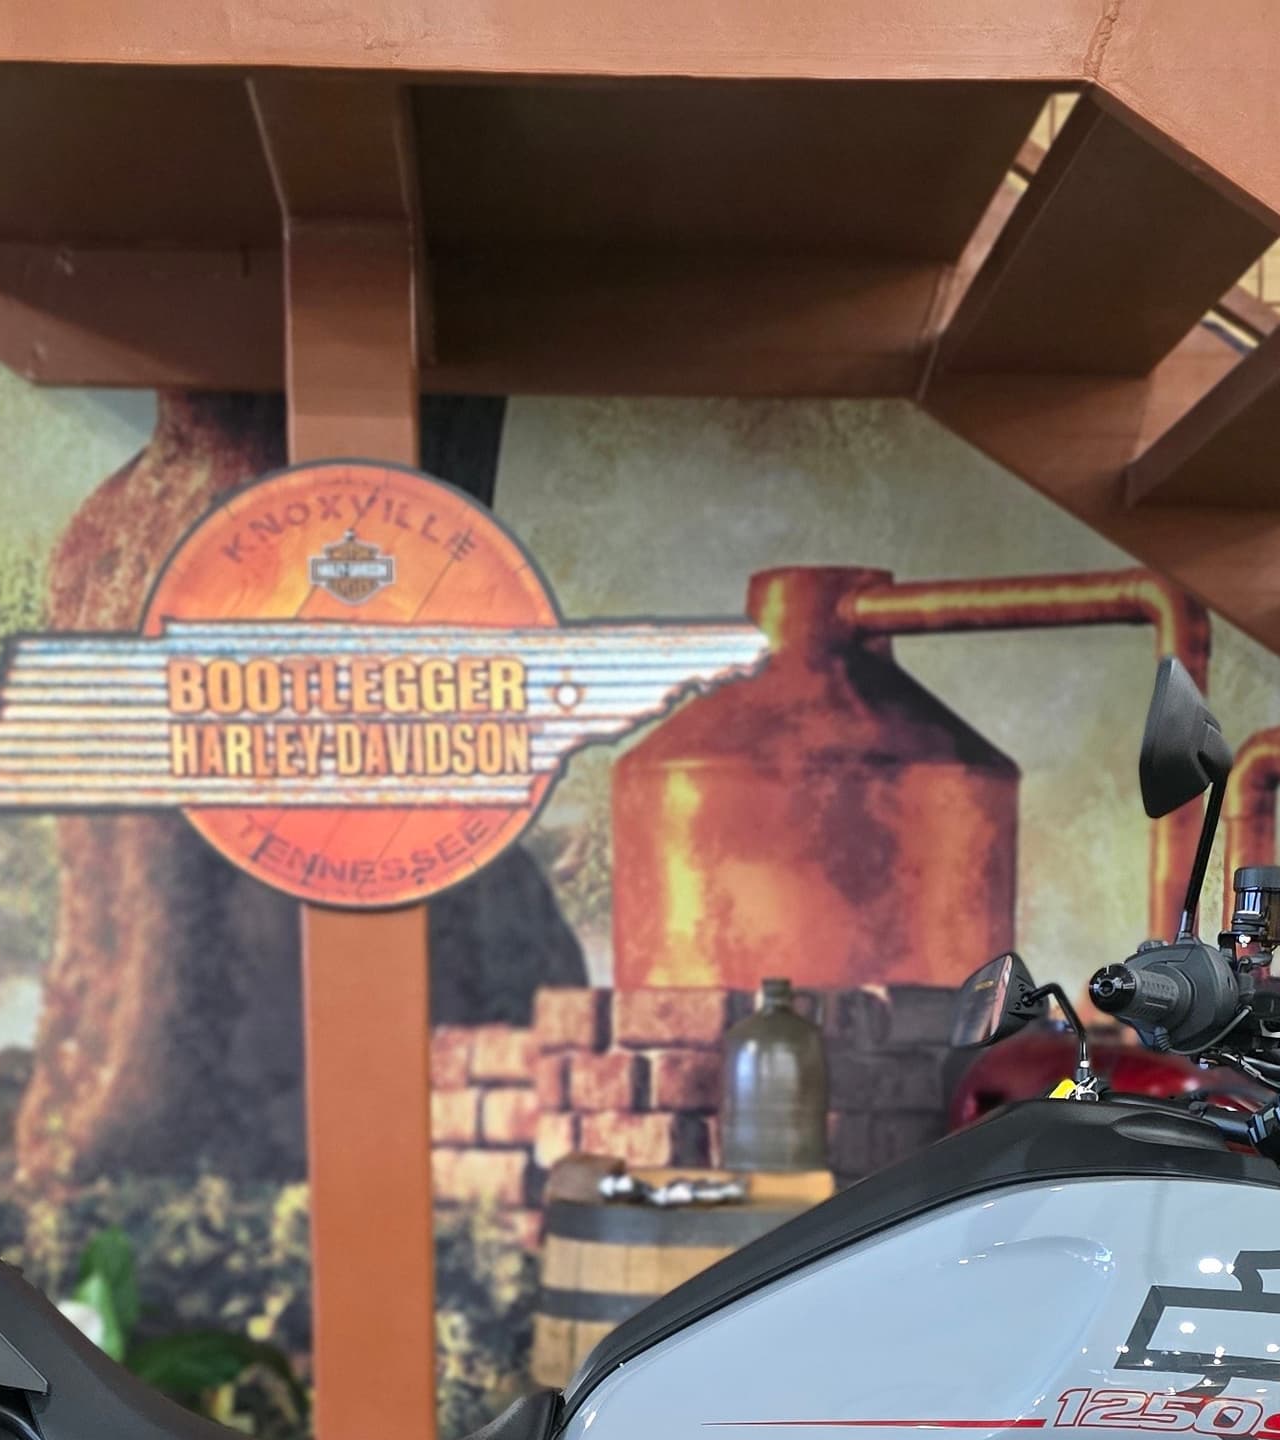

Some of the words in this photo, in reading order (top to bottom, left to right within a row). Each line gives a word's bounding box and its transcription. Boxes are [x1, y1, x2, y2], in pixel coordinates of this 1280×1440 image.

[223, 491, 476, 563] KNOXVILLE
[167, 657, 527, 714] BOOTLEGGER
[170, 722, 533, 777] HARLEY-DAVIDSON
[239, 811, 489, 887] TENNESSEE
